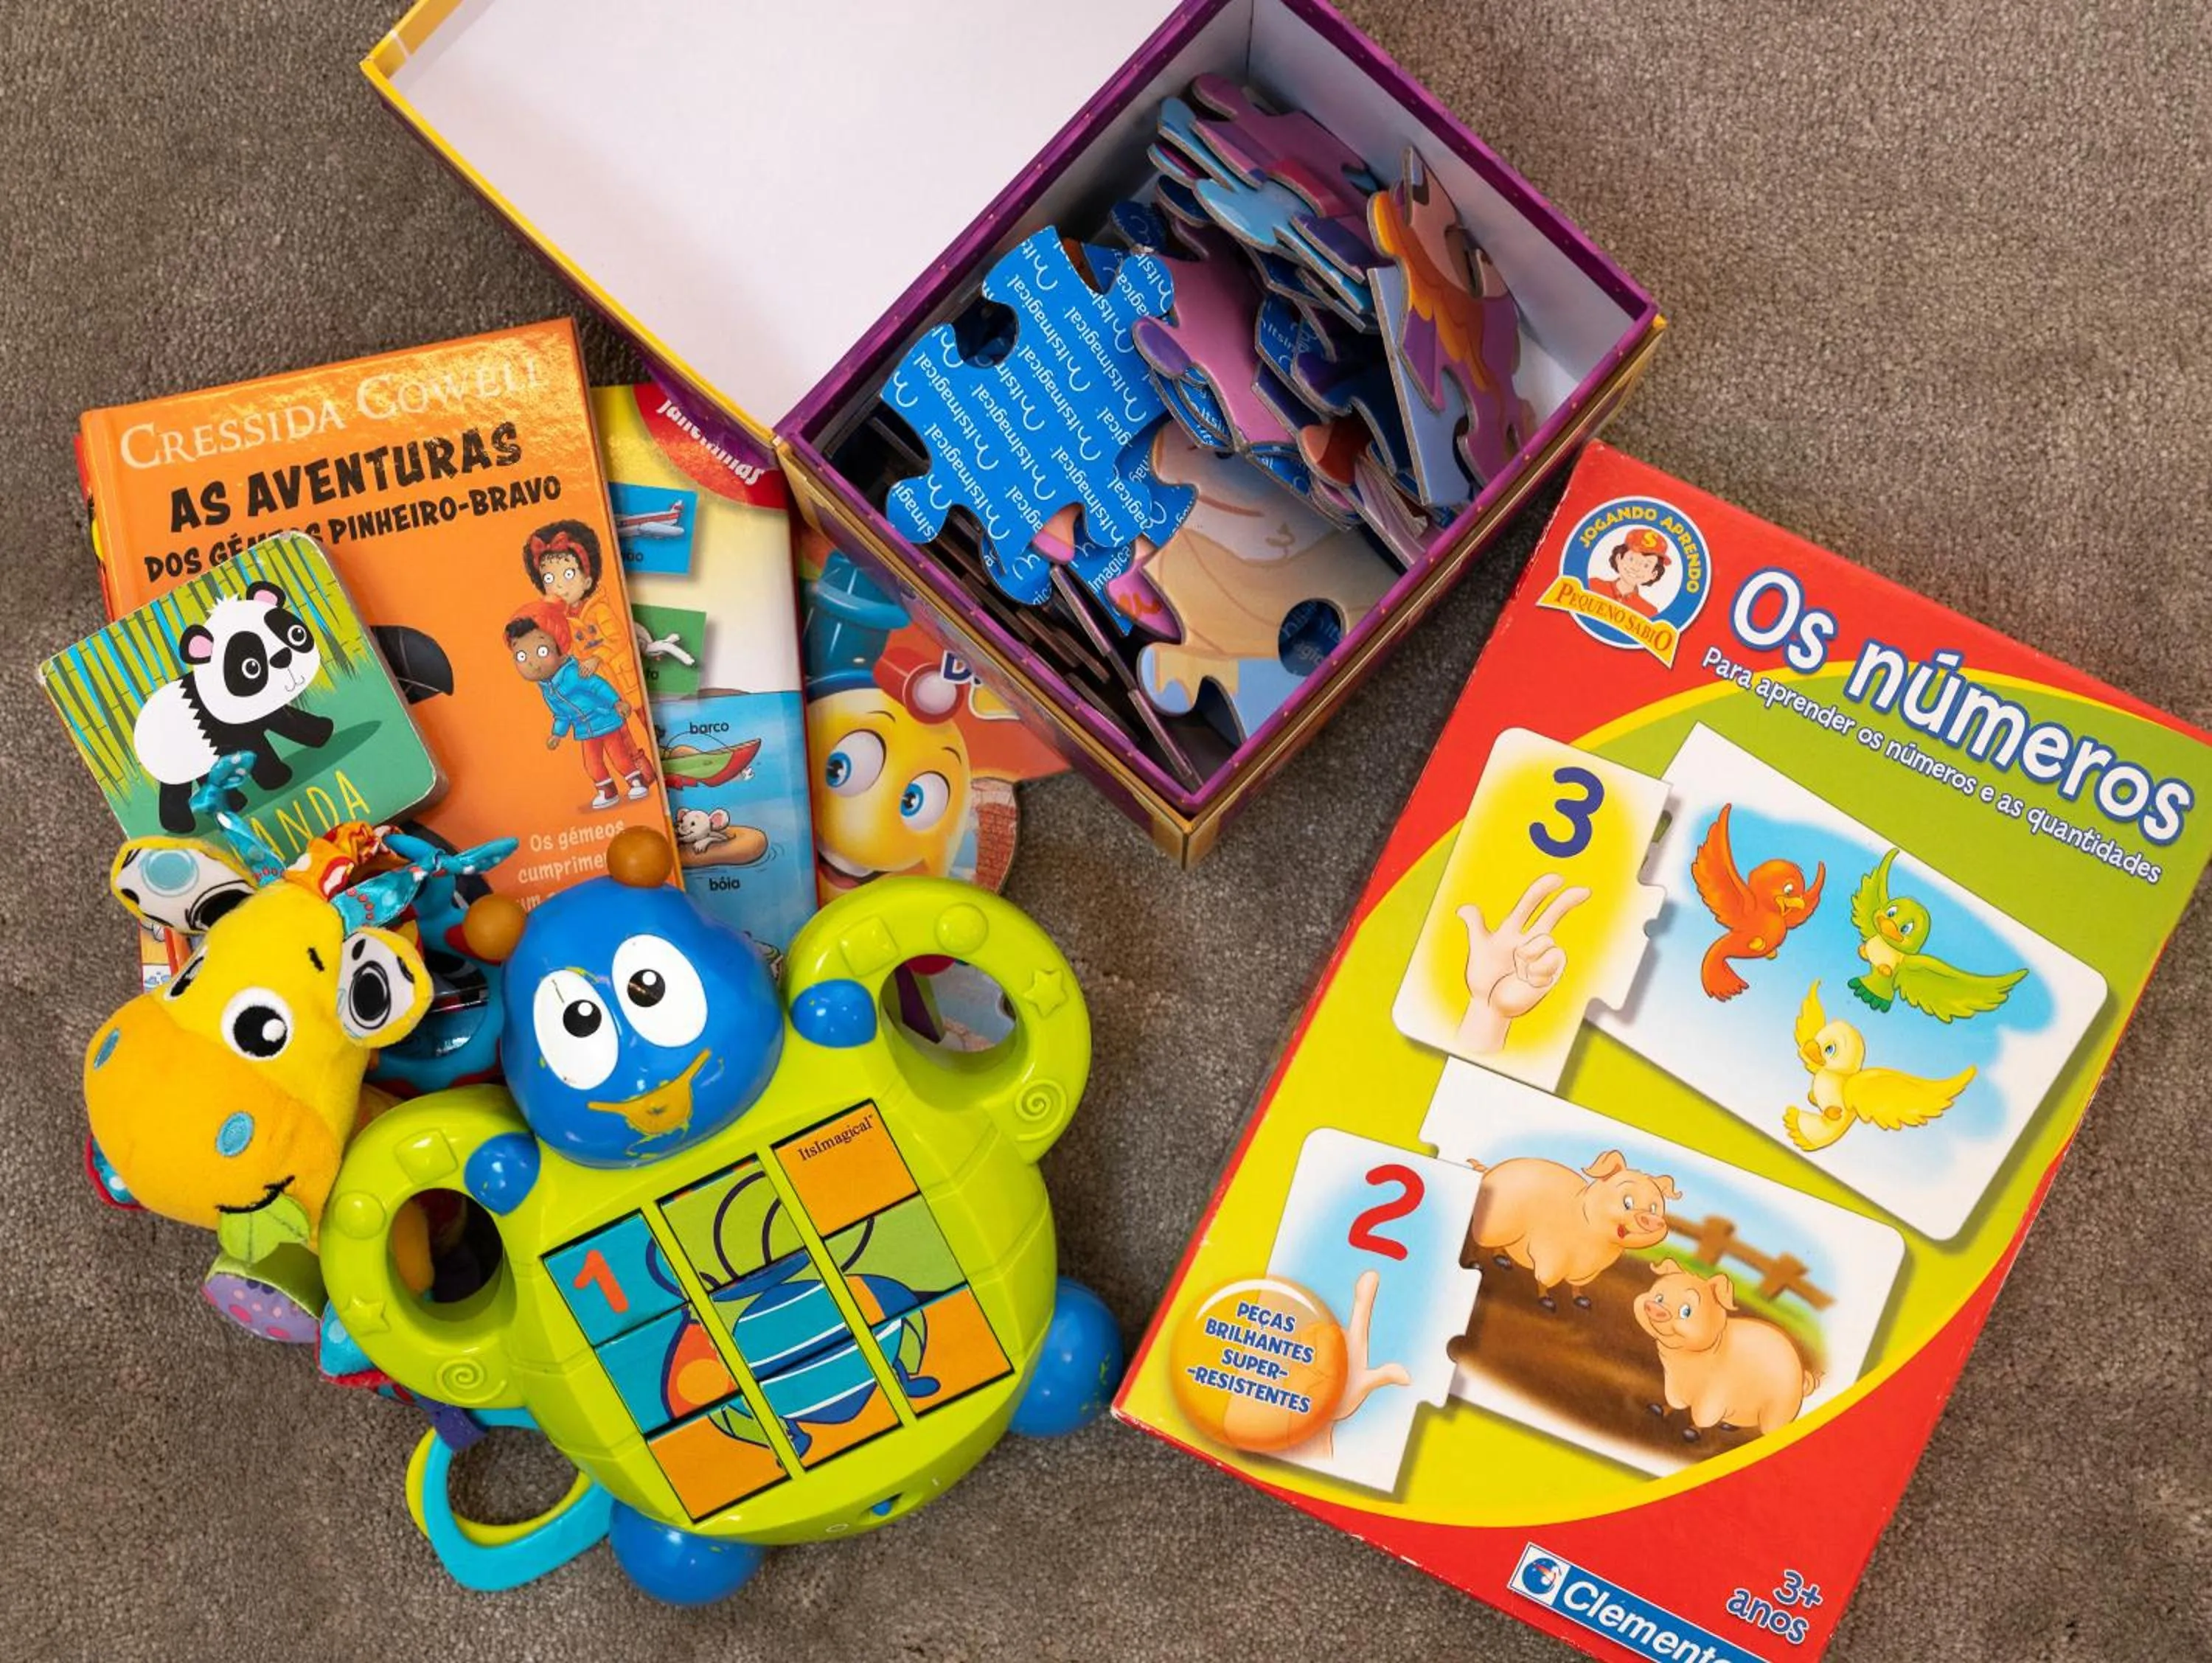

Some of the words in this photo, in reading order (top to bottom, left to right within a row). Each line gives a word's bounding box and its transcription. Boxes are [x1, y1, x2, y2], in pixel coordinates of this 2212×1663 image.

[1007, 276, 1069, 360] ItsImagical
[1064, 306, 1125, 391] ItsImagical
[914, 353, 977, 439] ItsImagical
[972, 384, 1034, 470] ItsImagical
[1018, 345, 1079, 430] ItsImagical
[120, 399, 347, 470] CRESSIDA
[170, 481, 231, 532] AS
[247, 421, 522, 517] AVENTURAS
[924, 424, 988, 509] ItsImagical
[144, 547, 203, 582] DOS
[328, 475, 562, 545] PINHEIRO-BRAVO
[1051, 446, 1113, 530] ItsImagical
[1579, 506, 1658, 548] JOGANDO
[1660, 516, 1702, 593] APRENDO
[1555, 581, 1626, 624] PEQUENO
[1625, 615, 1673, 652] SABIO
[689, 720, 729, 735] barco
[1731, 568, 1837, 672] Os
[1846, 640, 2193, 843] números
[1702, 646, 1753, 690] Para
[1755, 676, 1856, 735] aprender
[1857, 726, 1885, 751] os
[1885, 739, 1978, 796] números
[1979, 784, 1996, 803] e
[1997, 792, 2025, 819] as
[2026, 805, 2162, 885] quantidades
[232, 770, 370, 863] ANDA
[529, 834, 554, 852] Os
[558, 820, 625, 851] gémeos
[1528, 766, 1605, 859] 3
[797, 1115, 873, 1162] ItsImagical
[1348, 1163, 1425, 1261] 2
[572, 1249, 628, 1314] 1
[1237, 1301, 1295, 1333] PEÇAS
[1204, 1317, 1315, 1364] BRILHANTES
[1221, 1348, 1289, 1381] SUPER-
[1187, 1366, 1311, 1414] -RESISTENTES
[1562, 1580, 1730, 1663] Clement
[1726, 1588, 1809, 1645] anos
[1773, 1569, 1823, 1608] 3+
